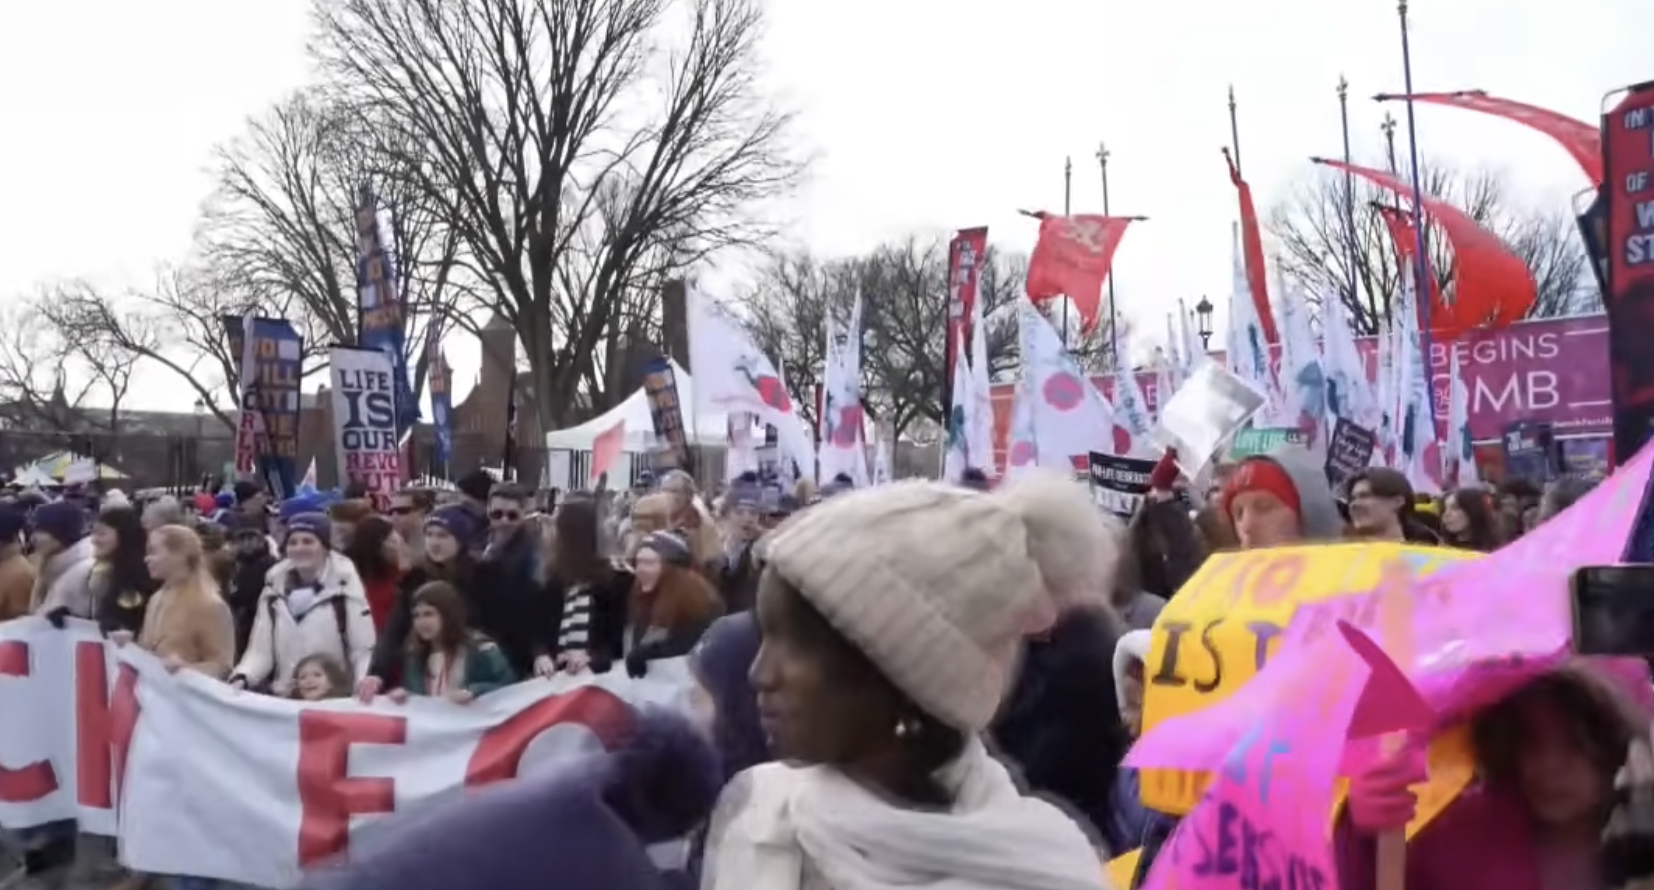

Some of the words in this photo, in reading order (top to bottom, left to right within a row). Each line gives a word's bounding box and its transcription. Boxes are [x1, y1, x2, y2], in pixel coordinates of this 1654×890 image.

[1430, 333, 1559, 368] BEGINS
[339, 369, 390, 391] LIFE
[342, 390, 395, 430] IS
[342, 430, 397, 451] OUR
